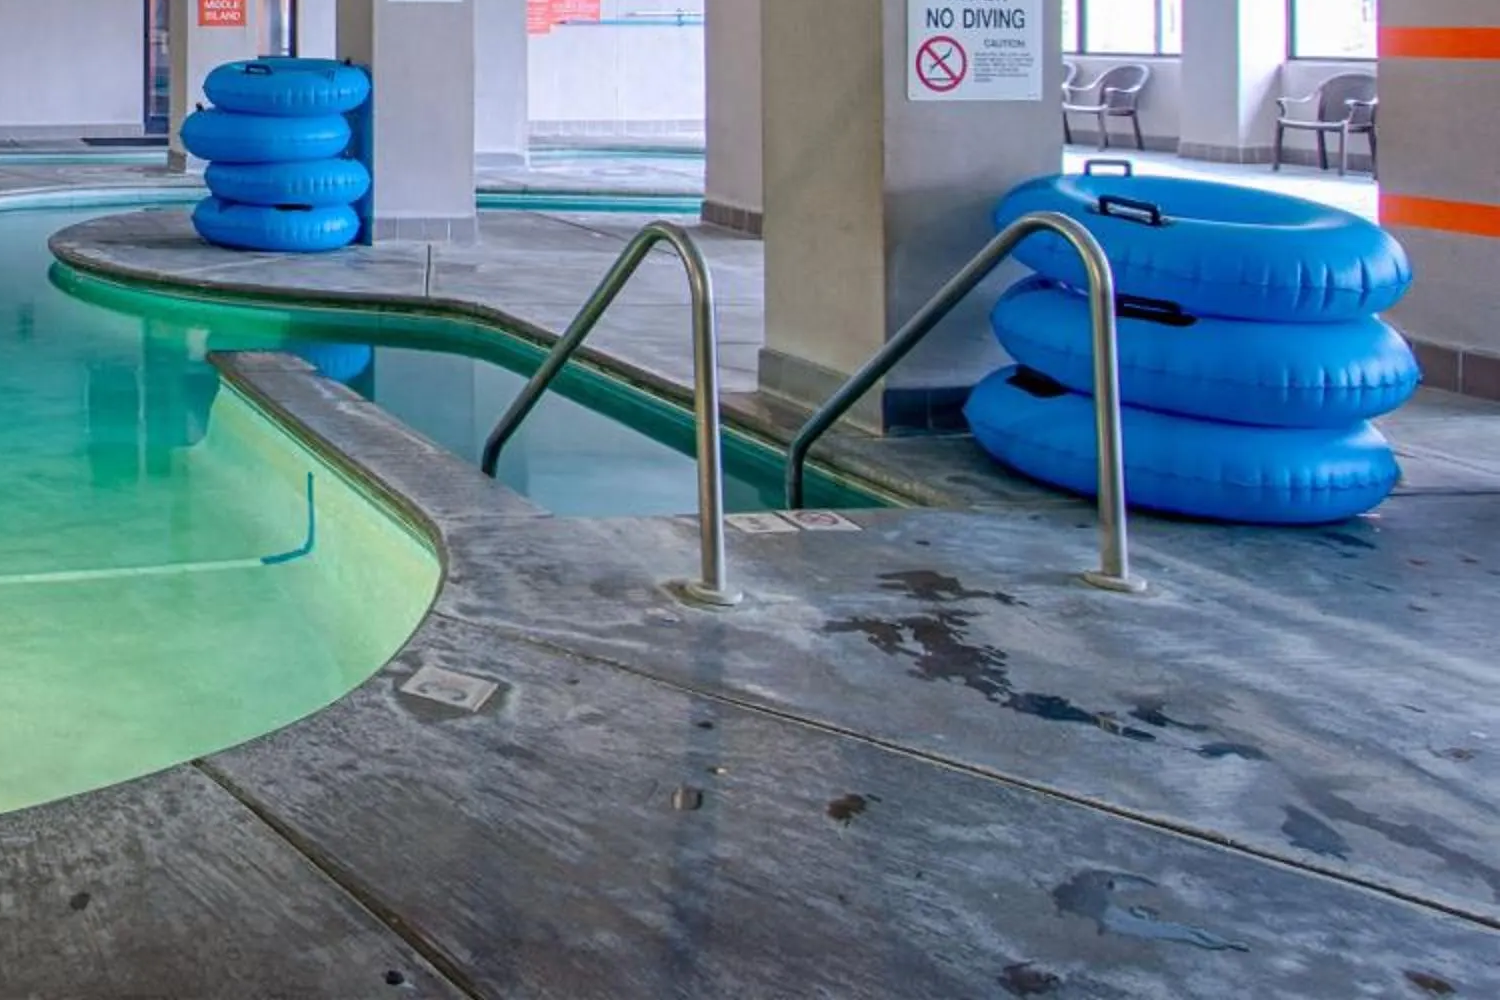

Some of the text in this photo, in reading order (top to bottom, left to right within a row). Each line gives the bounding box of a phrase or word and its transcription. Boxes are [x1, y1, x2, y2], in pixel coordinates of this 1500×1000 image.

[203, 0, 241, 9] MIDDLE
[204, 10, 241, 21] ISLAND
[926, 8, 1026, 29] NO DIVING
